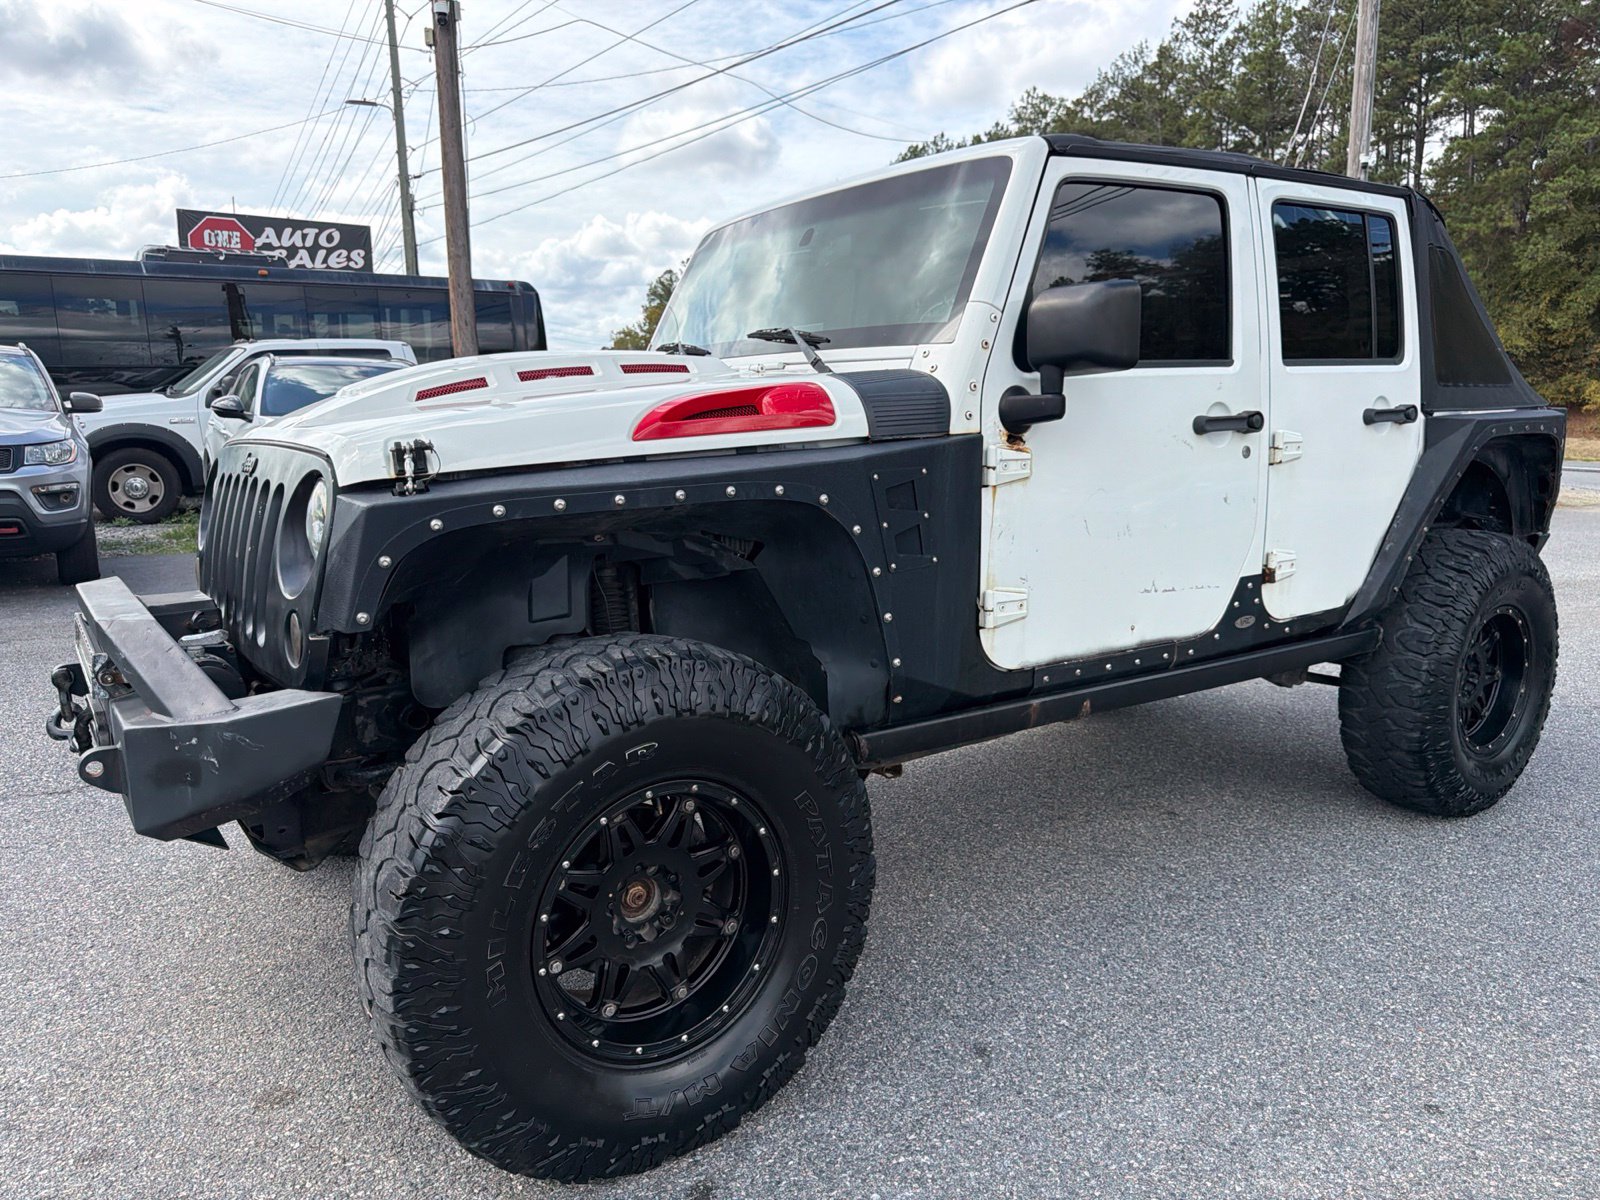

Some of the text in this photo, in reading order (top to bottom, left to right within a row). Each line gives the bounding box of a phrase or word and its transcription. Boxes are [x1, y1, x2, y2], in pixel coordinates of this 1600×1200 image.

[254, 226, 341, 248] AUTO
[486, 742, 659, 1008] MILESTAR
[623, 790, 834, 1122] PATAGONIA M/T
